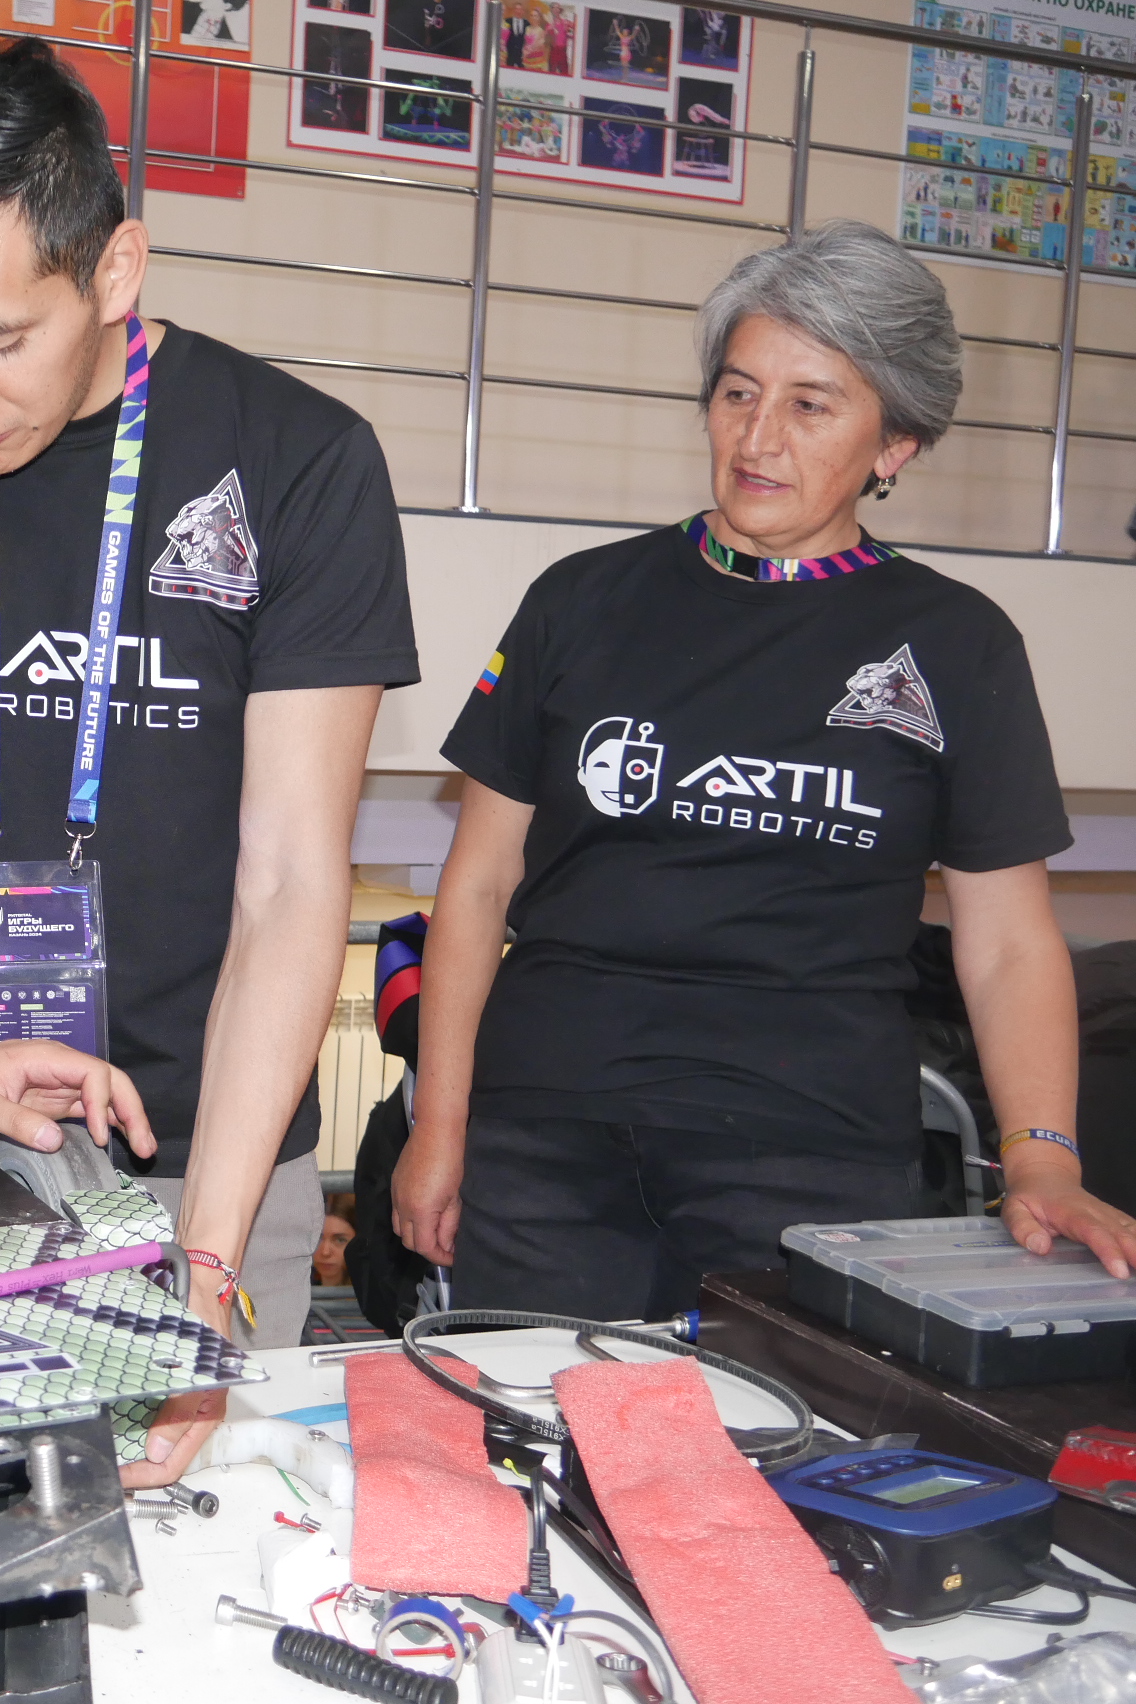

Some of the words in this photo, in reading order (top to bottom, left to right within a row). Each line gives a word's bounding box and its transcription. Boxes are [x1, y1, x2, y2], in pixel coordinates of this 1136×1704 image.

[1074, 0, 1136, 20] ОХРАНЕ
[101, 531, 121, 605] GAMES
[97, 611, 111, 639] OF
[90, 644, 107, 686] THE
[80, 690, 102, 771] FUTURE
[675, 754, 883, 818] ARTIL
[671, 800, 877, 849] ROBOTICS
[8, 917, 42, 925] ИГРЫ
[8, 924, 75, 933] БУДУЩЕГО
